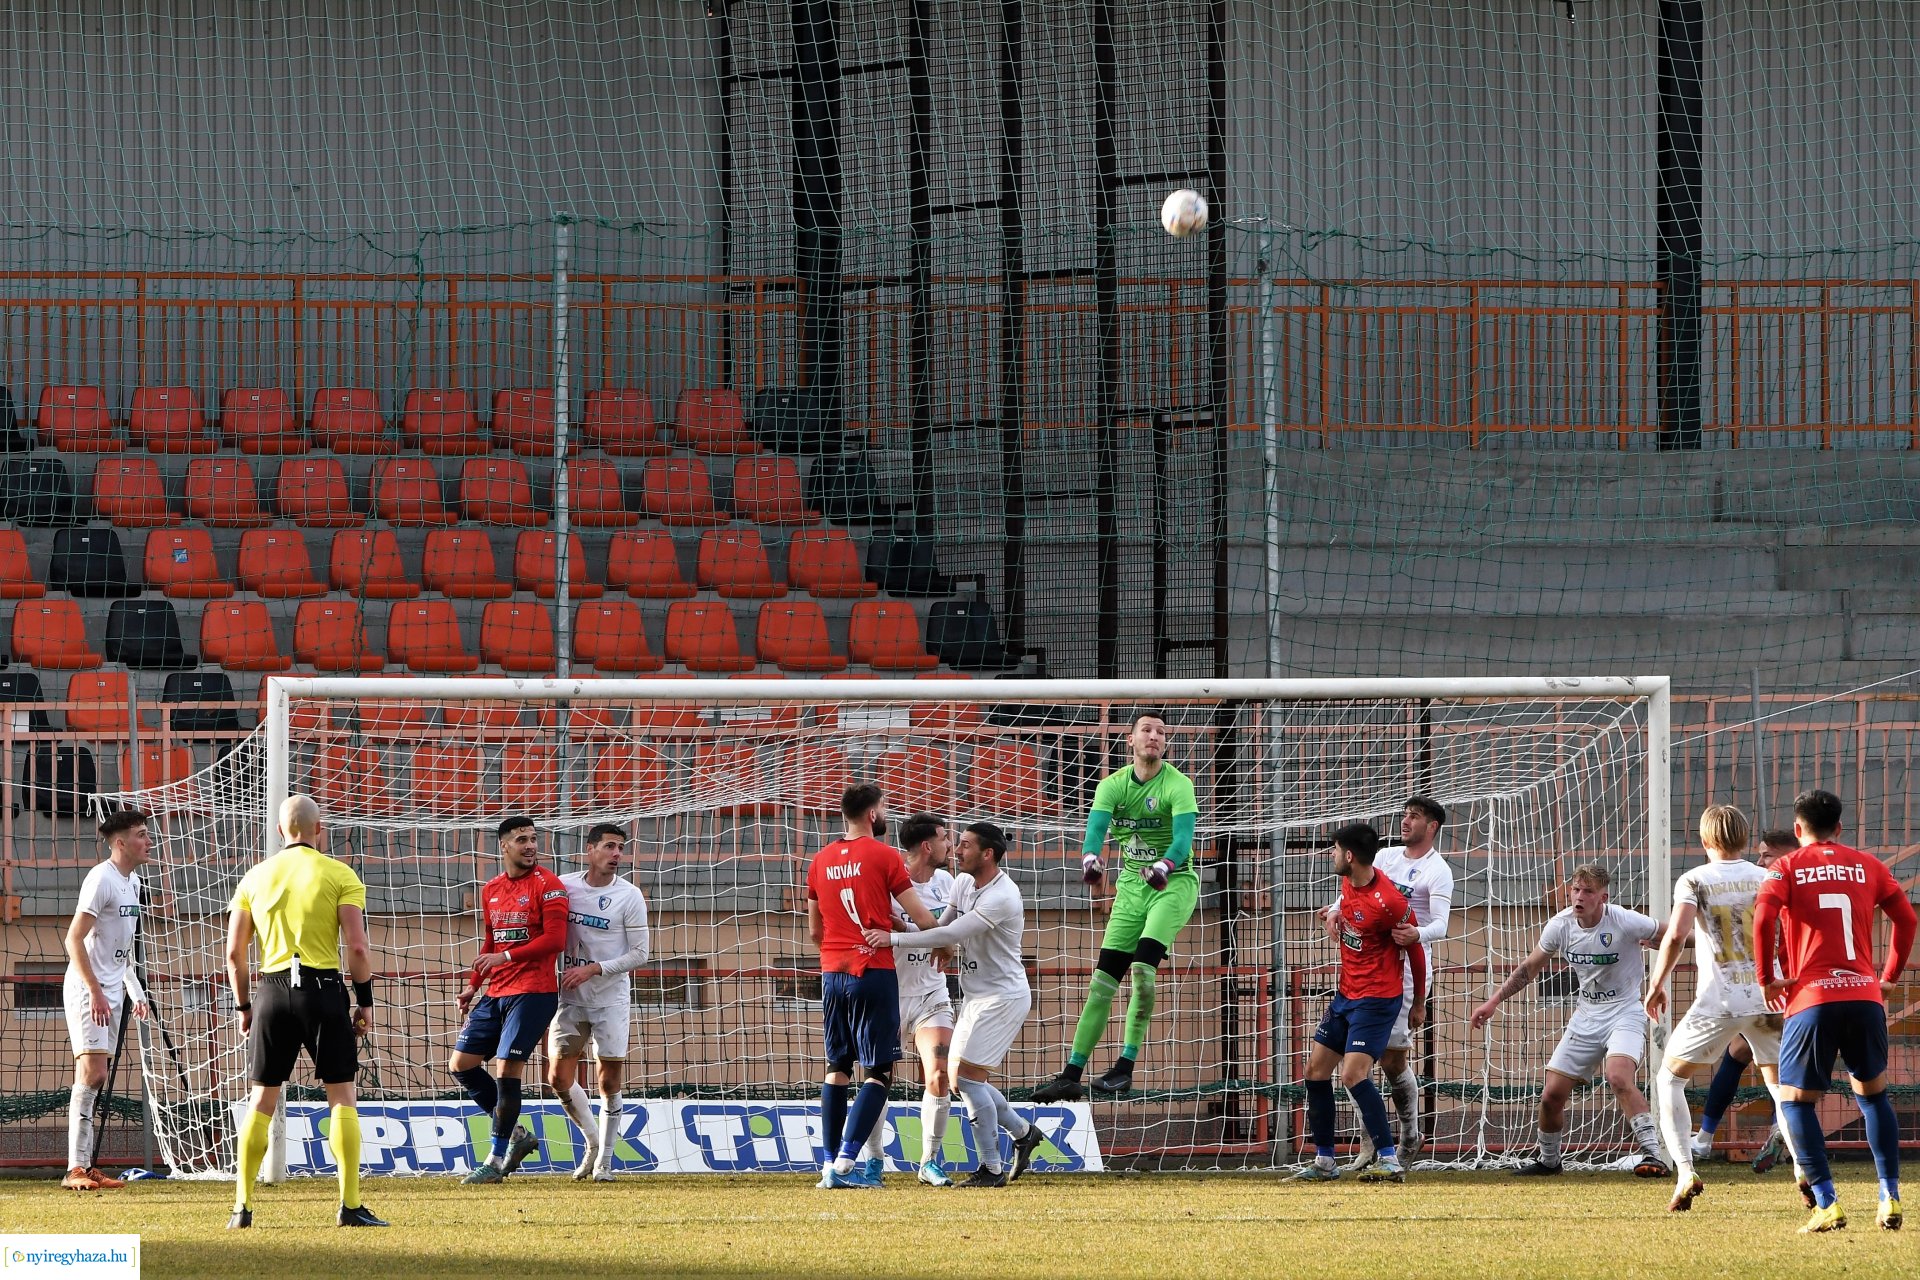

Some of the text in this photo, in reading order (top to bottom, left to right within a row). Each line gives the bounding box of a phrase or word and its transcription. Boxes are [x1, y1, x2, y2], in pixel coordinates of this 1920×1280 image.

[826, 861, 861, 880] NOVÁK
[1794, 864, 1865, 885] SZERETŐ
[1703, 879, 1760, 896] TISZAKÉCS
[568, 912, 609, 929] PPMIX
[1819, 893, 1856, 961] 7
[494, 929, 527, 941] PPMIX
[693, 1115, 1073, 1163] TiPMX
